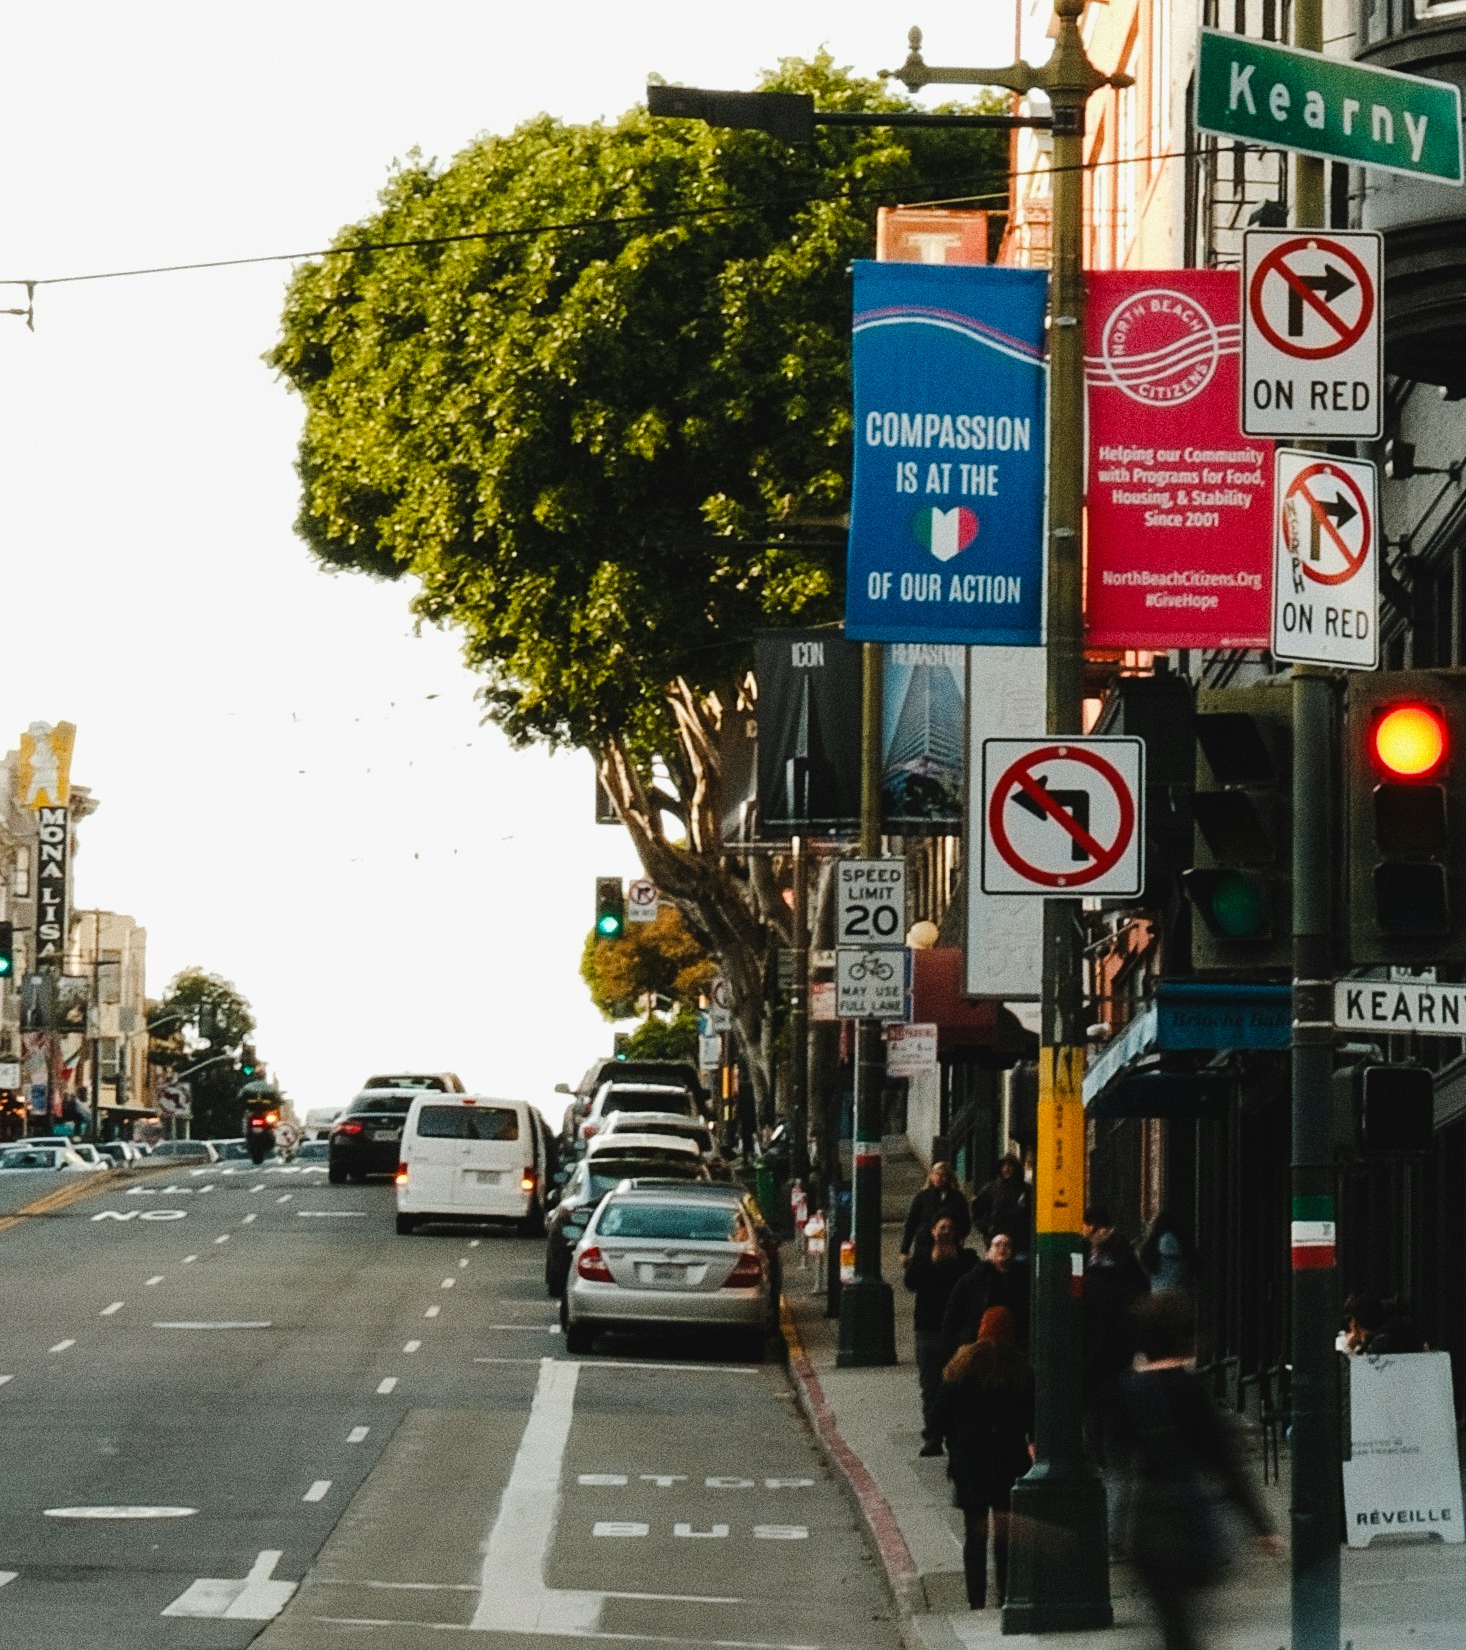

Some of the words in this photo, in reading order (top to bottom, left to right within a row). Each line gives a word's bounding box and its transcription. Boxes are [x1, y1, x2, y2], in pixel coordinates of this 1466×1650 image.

[1229, 61, 1428, 164] Kearny
[1112, 304, 1147, 357] NORTH
[1150, 299, 1204, 332] BEACH
[1138, 363, 1209, 399] CITIZENS
[1253, 379, 1293, 410] ON
[1310, 380, 1370, 412] RED
[865, 410, 1031, 452] COMPASSION
[1099, 445, 1154, 465] Helping
[1156, 449, 1181, 462] our
[1184, 446, 1265, 466] Community
[896, 461, 918, 494] IS
[925, 462, 952, 495] AT
[959, 463, 999, 496] THE
[1098, 467, 1130, 483] with
[1133, 468, 1200, 487] Programs
[1202, 468, 1223, 484] for
[1226, 469, 1266, 487] Food,
[1112, 489, 1174, 508] Housing,
[1177, 491, 1188, 504] &
[1191, 489, 1253, 509] Stability
[1144, 509, 1183, 527] Since
[1185, 511, 1220, 528] 2001
[867, 571, 893, 601] OF
[900, 572, 942, 602] OUR
[949, 574, 1022, 604] ACTION
[1102, 570, 1263, 590] NorthBeachCitizens.Org
[1145, 591, 1220, 611] #GiveHope
[1282, 602, 1314, 635] ON
[1325, 606, 1370, 641] RED
[791, 642, 825, 667] ICON
[38, 807, 66, 879] MONA
[842, 868, 901, 883] SPEED
[848, 886, 894, 901] LIMIT
[38, 886, 63, 958] LISA
[844, 904, 899, 937] 20
[842, 985, 868, 997] MAY
[875, 985, 900, 997] USE
[840, 1000, 867, 1012] FULL
[871, 1000, 901, 1012] LANE
[89, 1208, 188, 1222] NO
[576, 1473, 816, 1489] STOP
[1356, 1507, 1452, 1526] RÉVEILLE
[591, 1520, 810, 1540] BUS
